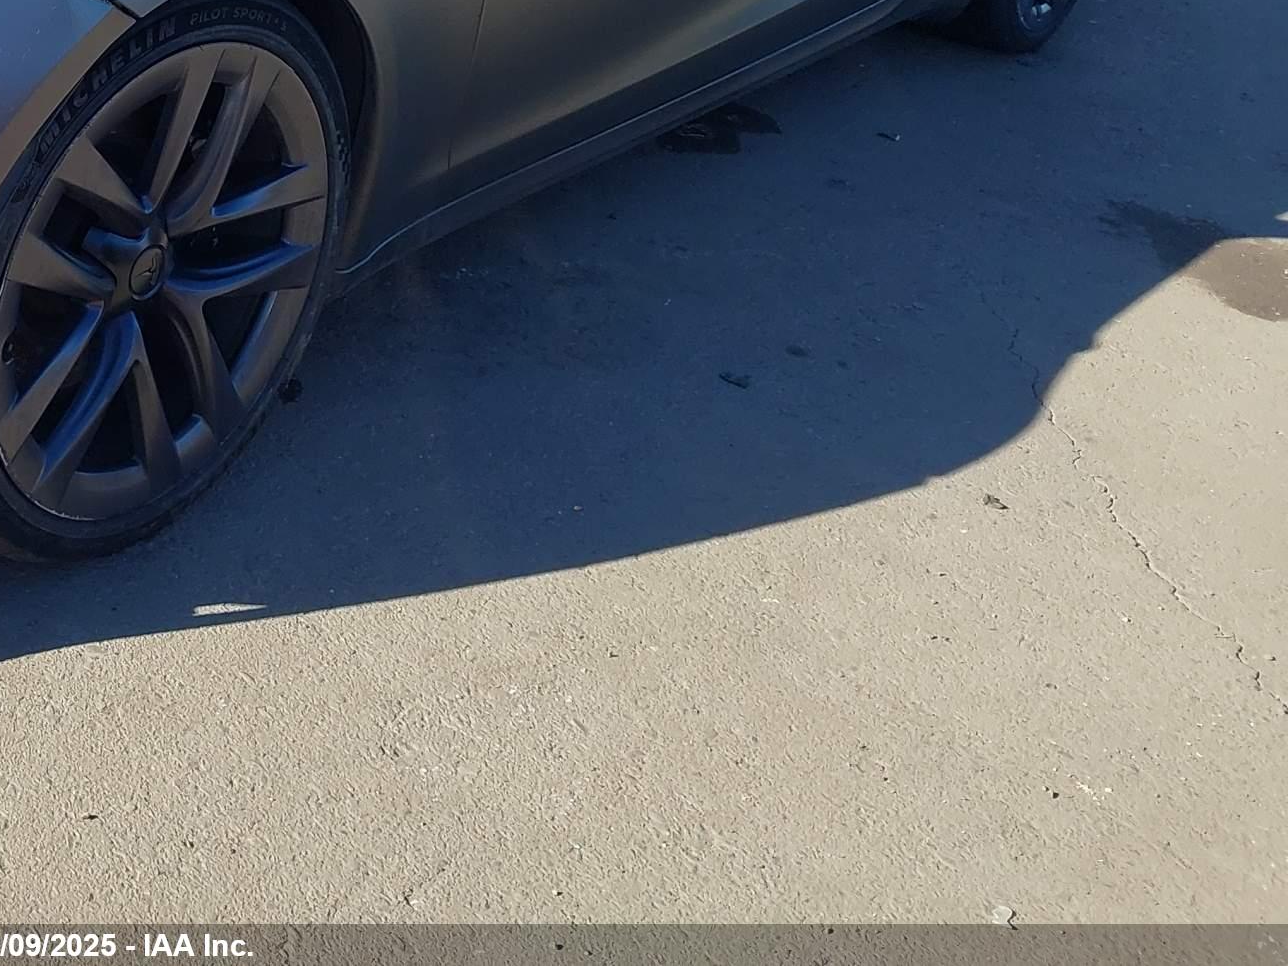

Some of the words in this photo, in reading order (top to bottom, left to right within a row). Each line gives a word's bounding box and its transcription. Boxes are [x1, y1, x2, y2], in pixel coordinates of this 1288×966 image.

[38, 17, 177, 154] MICHELIN
[189, 6, 229, 26] PILOT
[233, 6, 273, 25] SPORT
